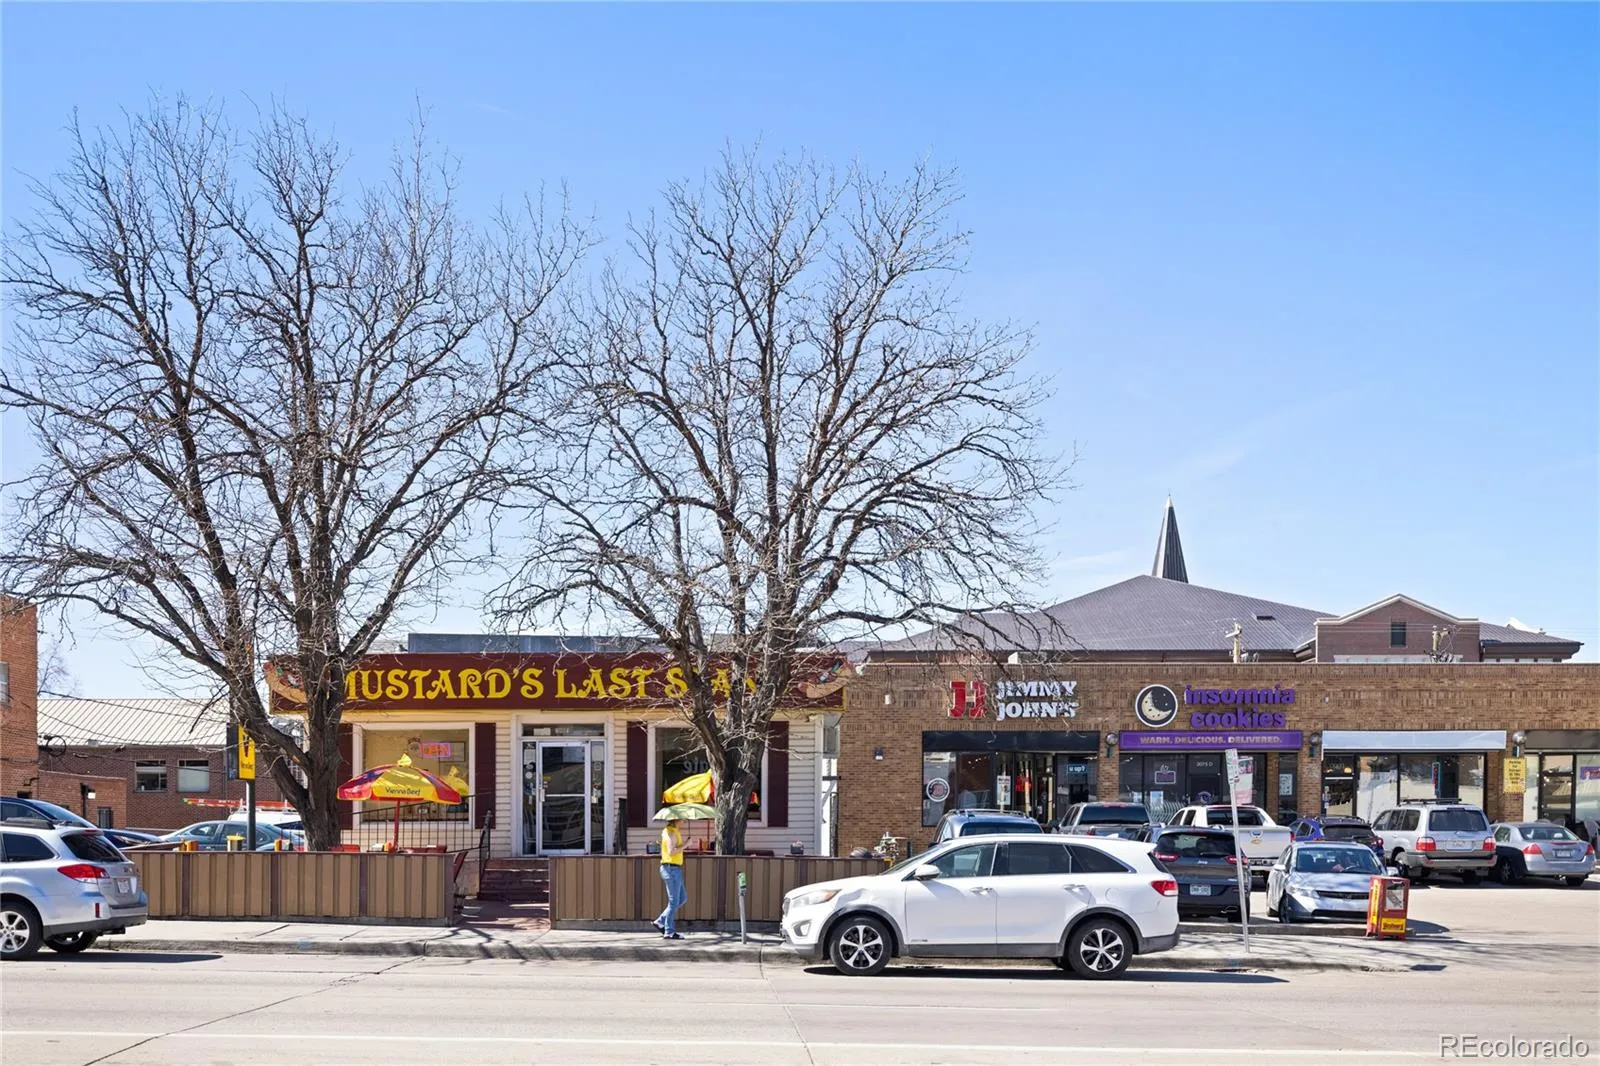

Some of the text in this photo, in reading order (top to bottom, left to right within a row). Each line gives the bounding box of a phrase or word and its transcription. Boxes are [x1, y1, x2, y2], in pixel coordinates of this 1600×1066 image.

[343, 667, 545, 700] MUSTARD'S
[555, 668, 654, 699] LAST
[996, 680, 1077, 700] JIMMY
[1184, 684, 1296, 706] insomnia
[1190, 706, 1287, 728] cookies
